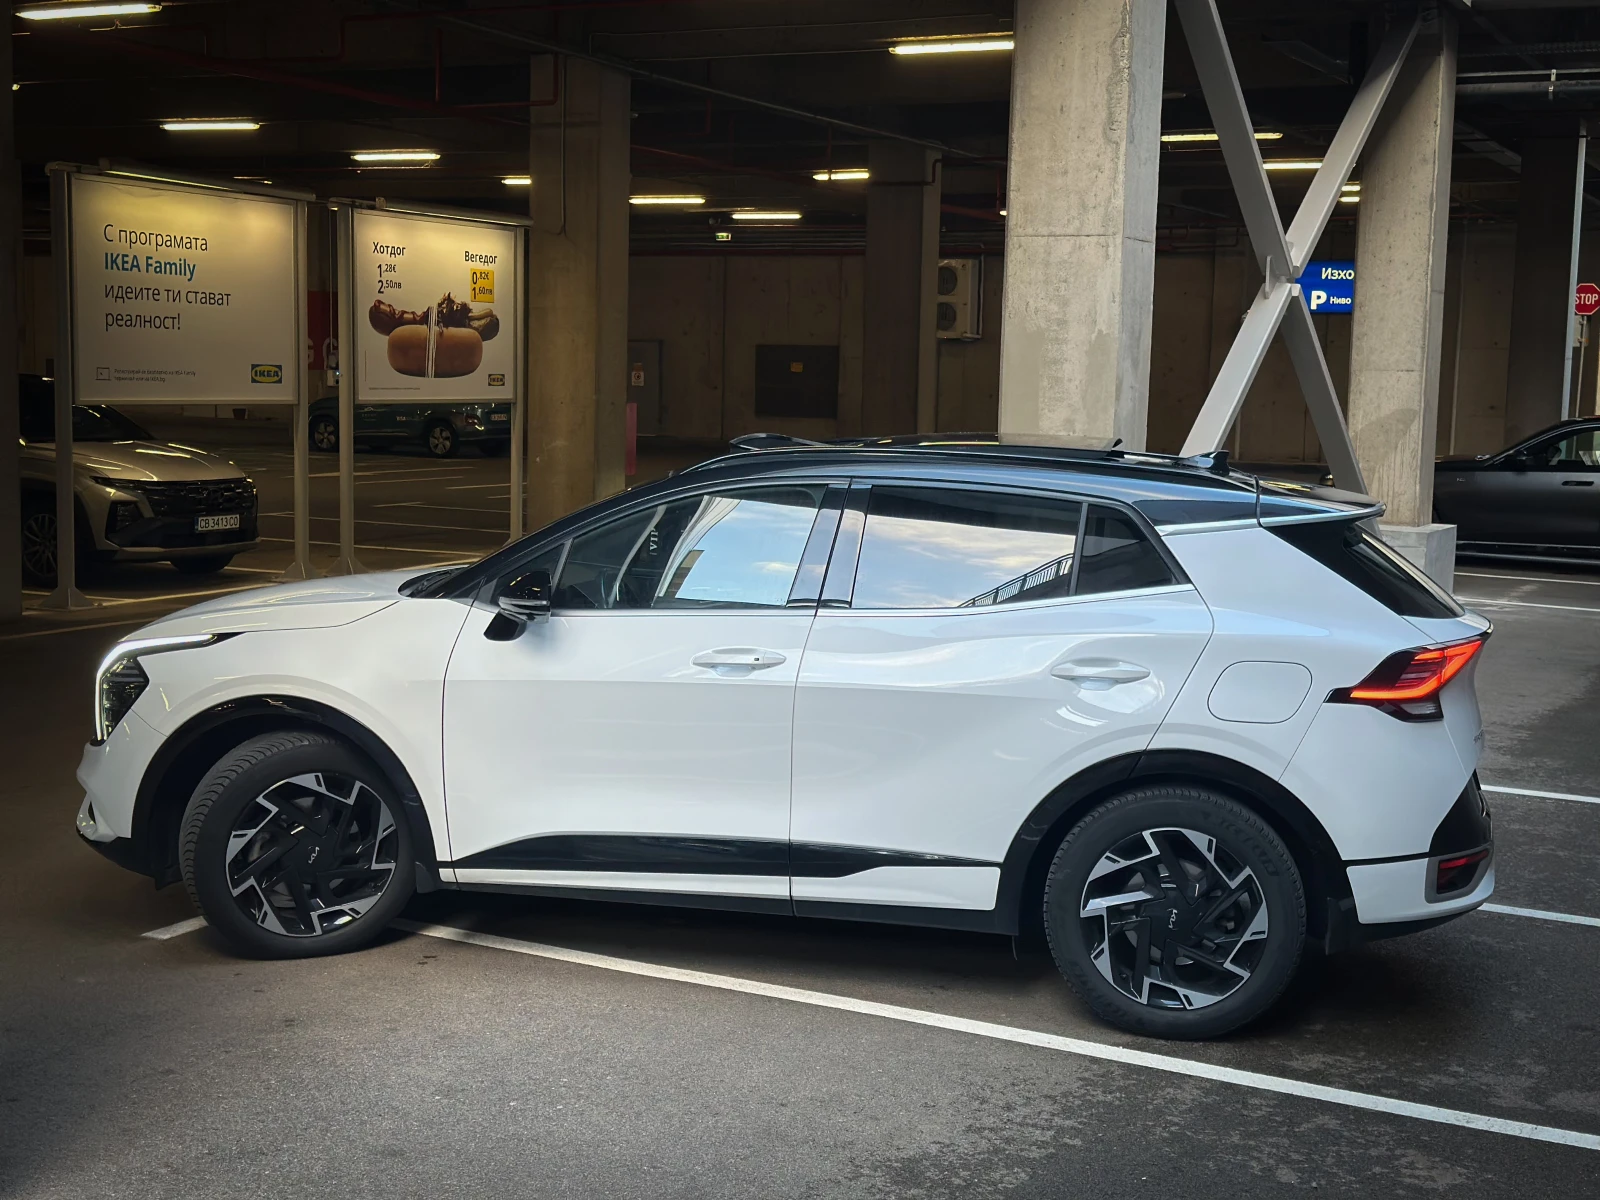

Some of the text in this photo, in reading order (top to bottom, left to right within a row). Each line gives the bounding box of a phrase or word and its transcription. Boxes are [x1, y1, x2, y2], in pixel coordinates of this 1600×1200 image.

[104, 224, 208, 251] С програмата
[372, 241, 406, 258] Хотдог
[464, 250, 498, 266] Вегедог
[104, 252, 196, 282] IKEA Family
[105, 284, 231, 306] идеите ти стават
[1329, 296, 1352, 305] Ниво
[1575, 293, 1598, 305] STOP
[105, 312, 181, 332] реалност!
[254, 369, 280, 378] IKEA
